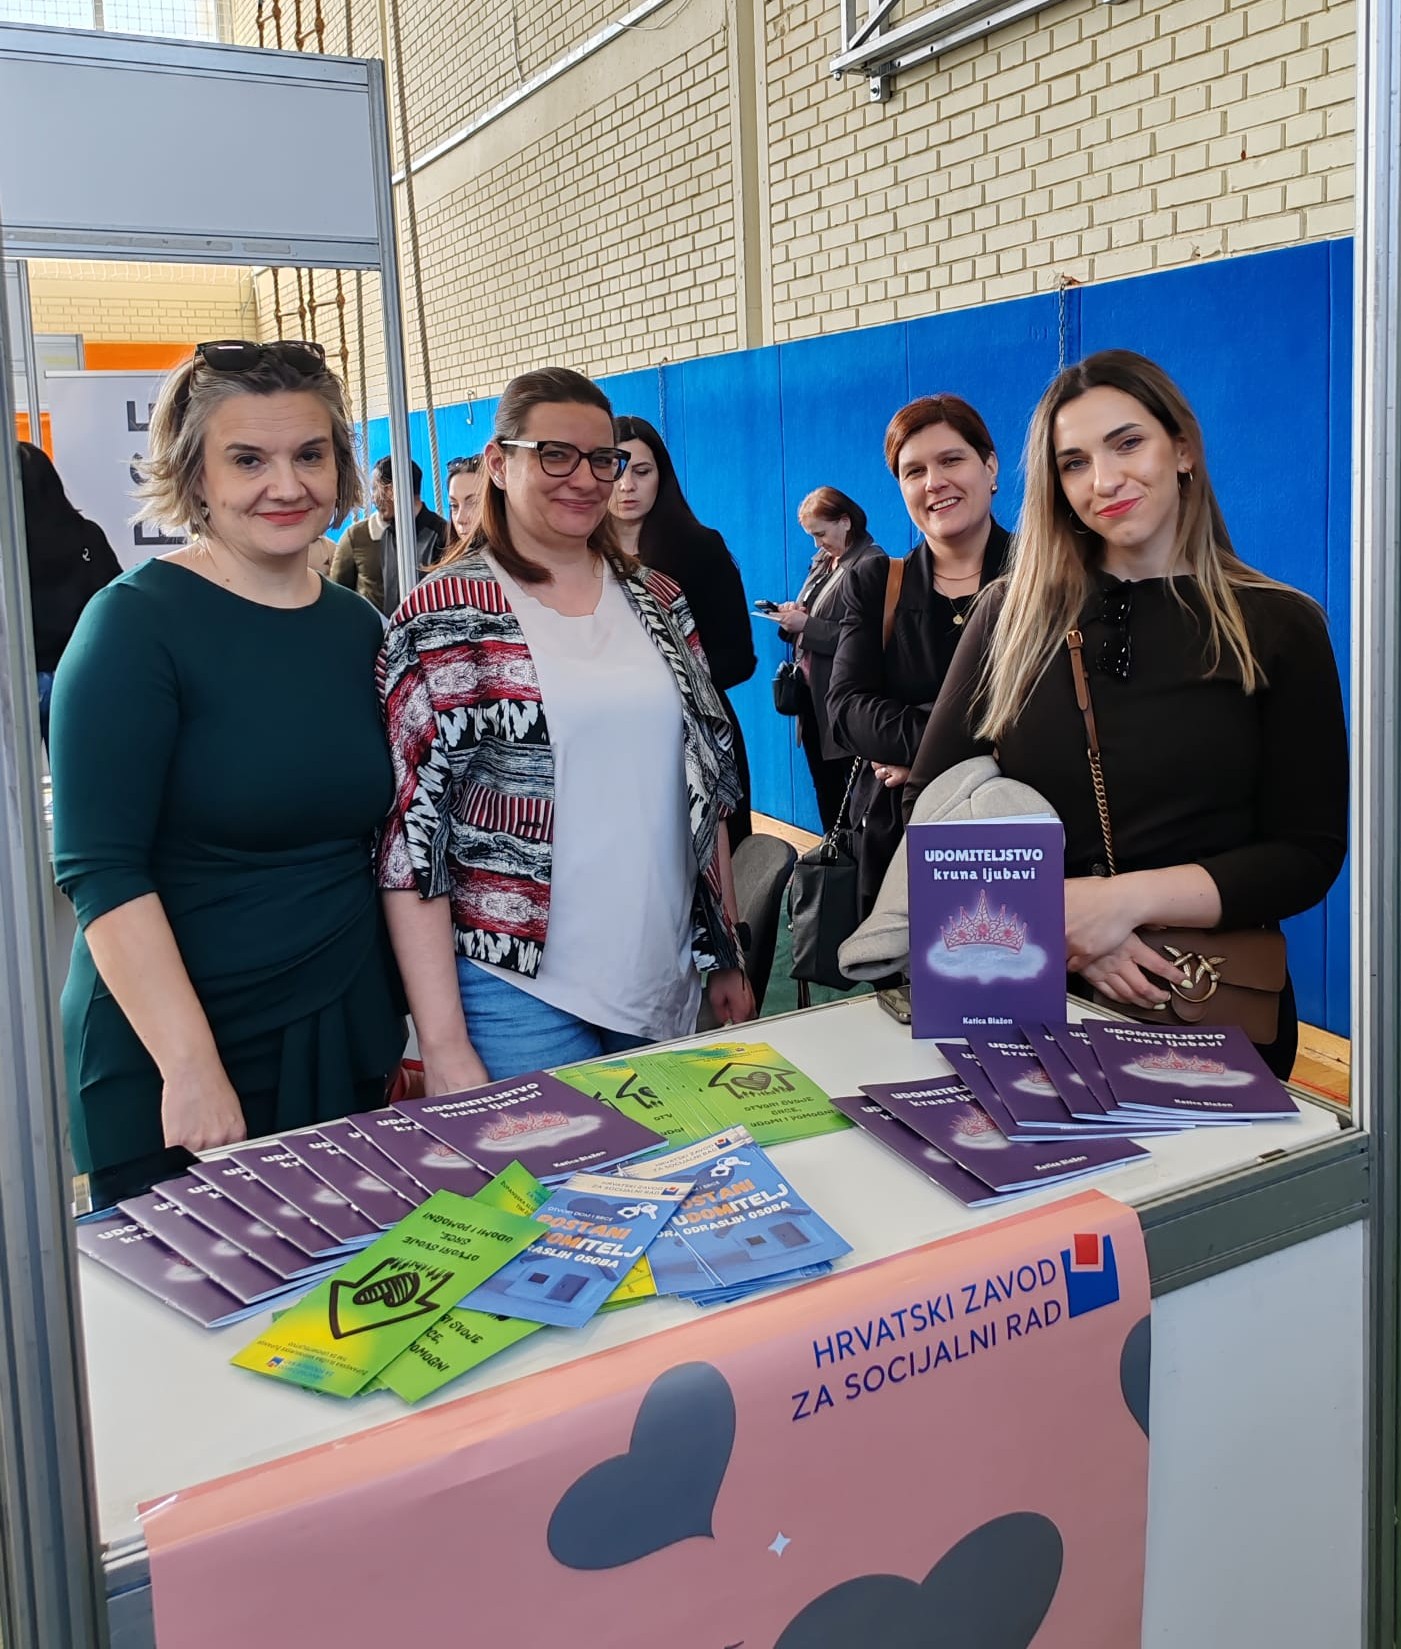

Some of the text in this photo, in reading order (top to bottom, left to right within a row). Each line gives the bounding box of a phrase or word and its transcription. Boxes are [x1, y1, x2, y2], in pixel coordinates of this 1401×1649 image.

[924, 848, 1043, 862] UDOMITELJSTVO
[933, 867, 1036, 883] kruna ljubavi
[962, 1017, 987, 1025] Katica
[1103, 1027, 1226, 1040] UDOMITELJSTVO
[1116, 1034, 1222, 1047] kruna ljubavi
[421, 1082, 540, 1114] UDOMITELJSTVO
[439, 1091, 543, 1119] kruna ljubavi
[909, 1098, 956, 1107] kruna
[671, 1183, 790, 1226] UDOMITELJ
[422, 1211, 469, 1232] POMOGNI
[682, 1200, 791, 1235] ODRASLIH OSOBA
[477, 1227, 514, 1243] UDOMI
[543, 1232, 643, 1258] OMITELJ
[402, 1235, 480, 1262] OTVORI SVOJE
[574, 1253, 620, 1269] OSOBA
[812, 1258, 1056, 1368] HRVATSKI ZAVOD
[449, 1319, 484, 1344] SVOJE
[791, 1299, 1062, 1422] ZA SOCIJALNI RAD
